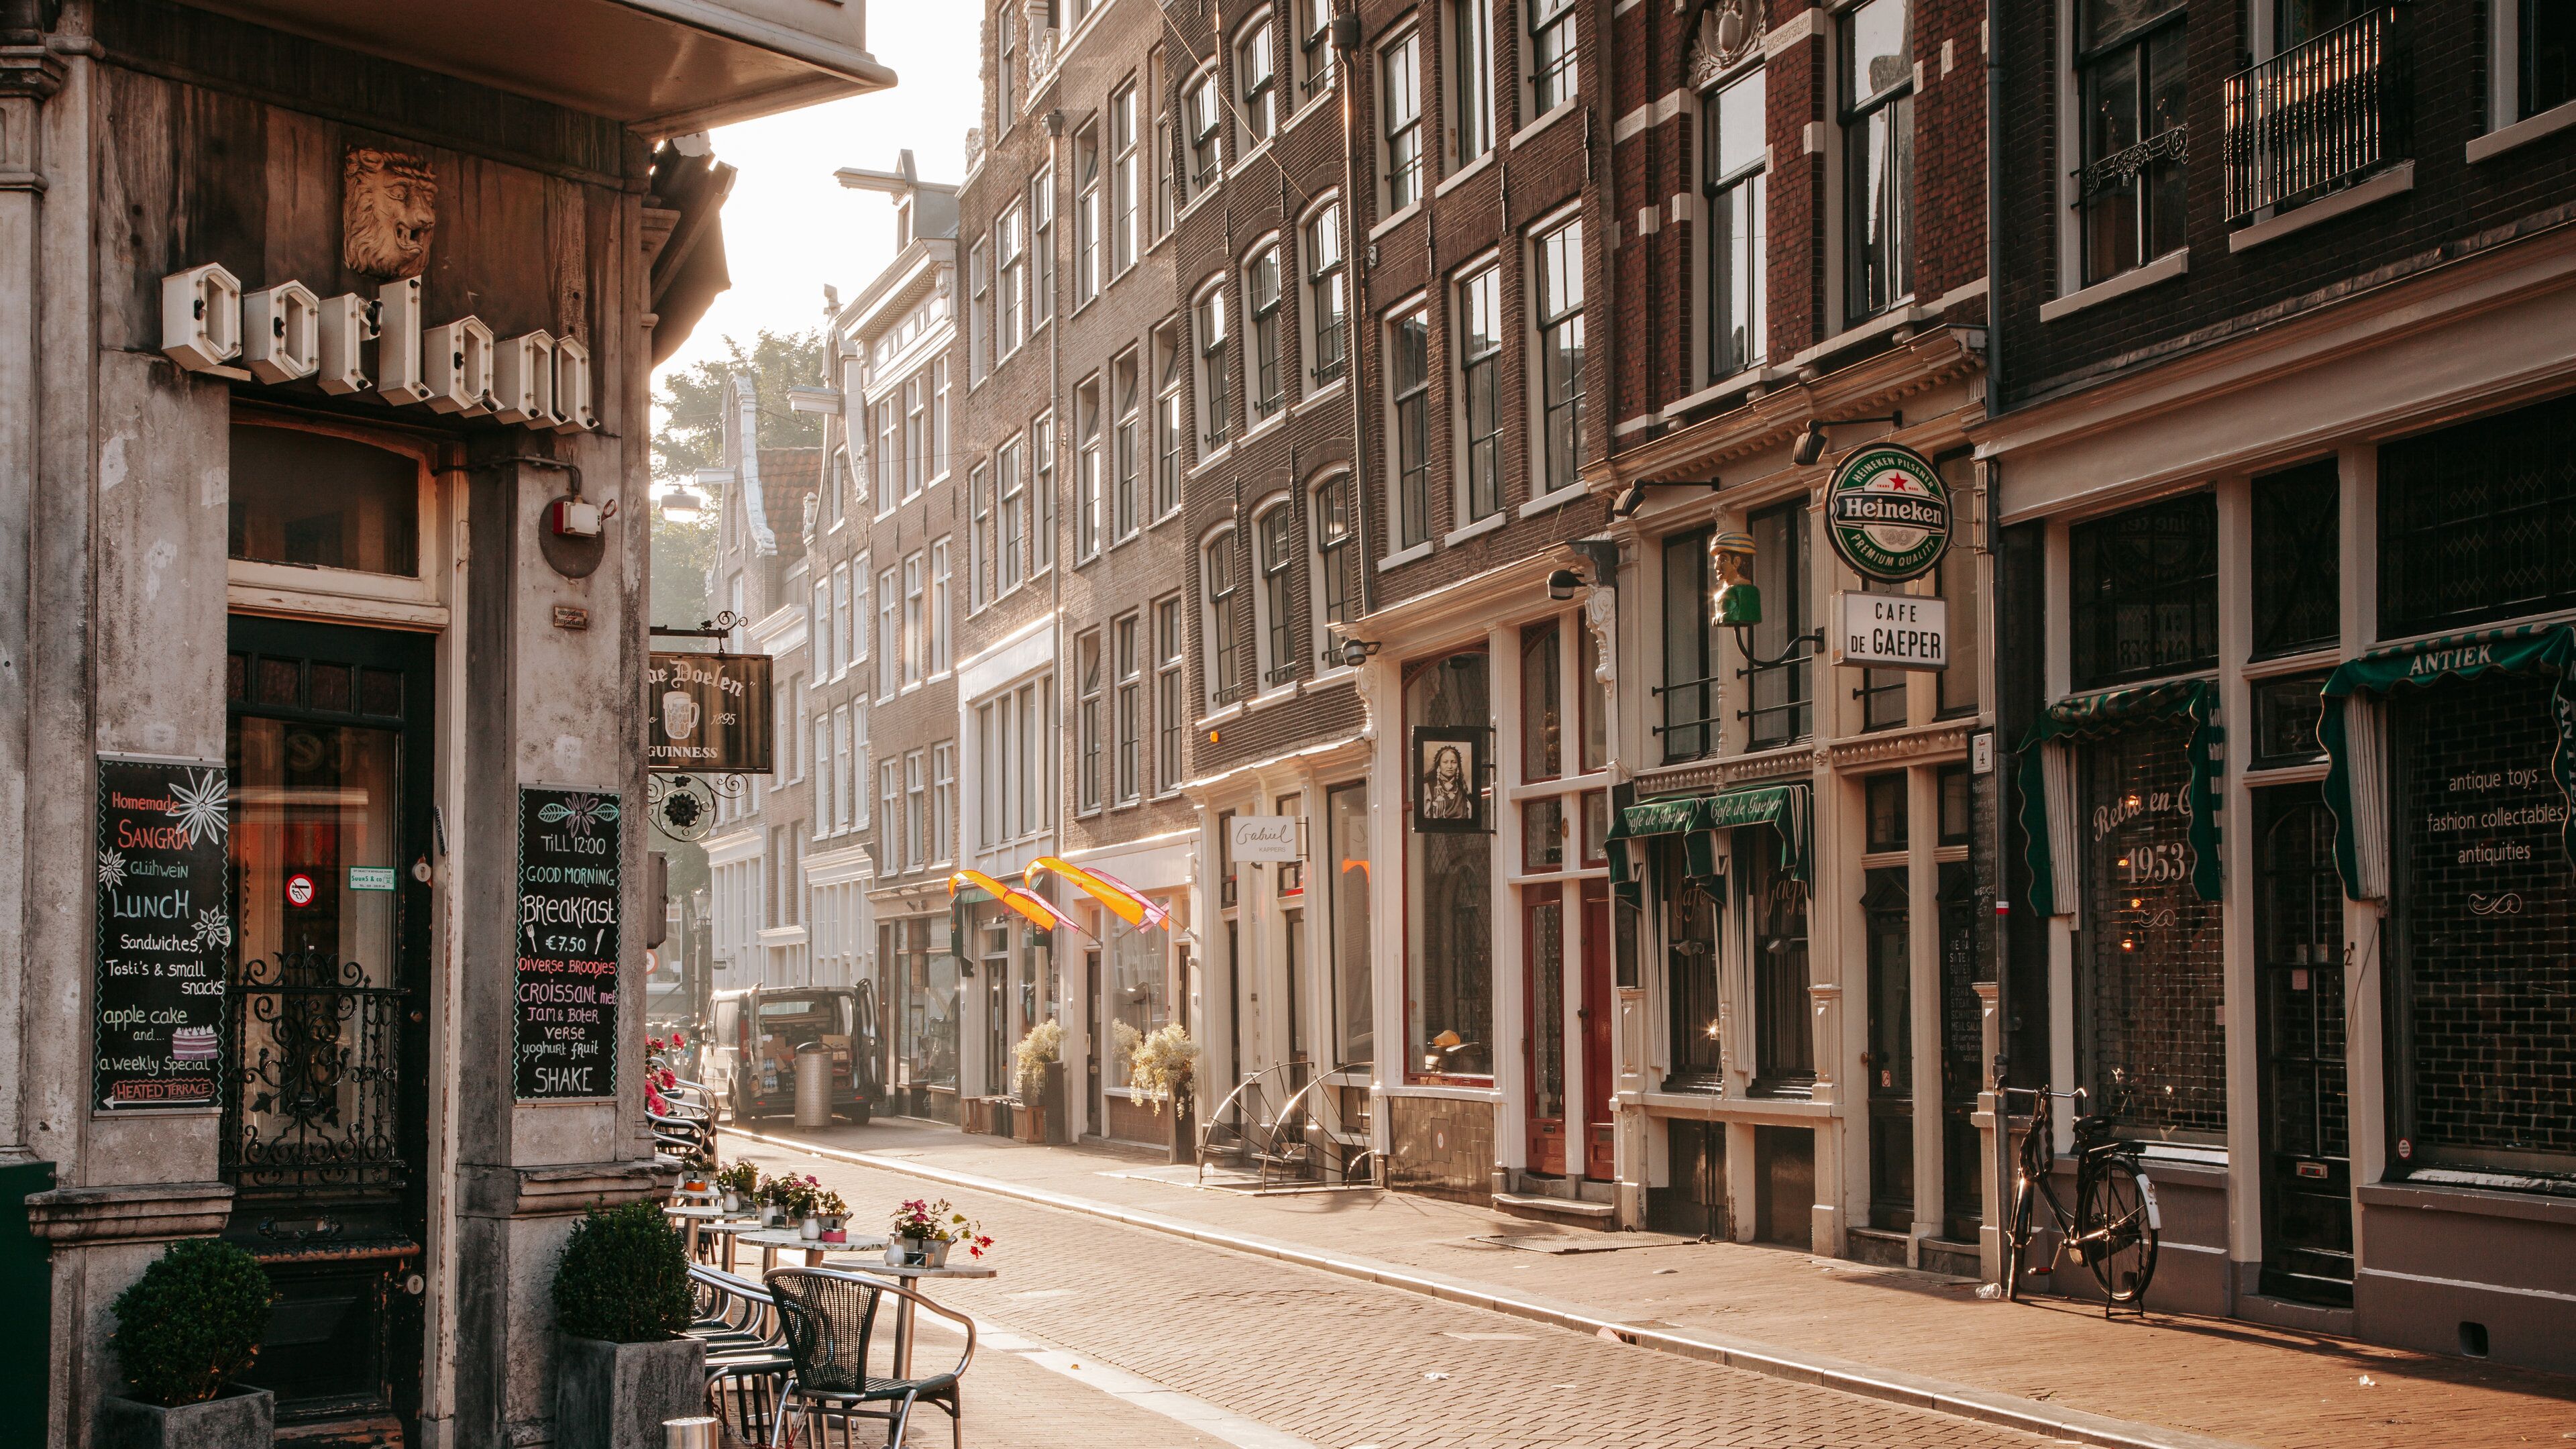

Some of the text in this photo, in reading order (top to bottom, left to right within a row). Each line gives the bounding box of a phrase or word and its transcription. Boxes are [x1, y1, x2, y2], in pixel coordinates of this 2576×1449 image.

[1852, 458, 1934, 488] HEINEKEN PILSENER
[1845, 498, 1942, 525] Heineken
[1850, 533, 1894, 568] PREMIUM
[1898, 539, 1935, 568] QUALITY
[1875, 602, 1917, 623] CAFE
[1851, 628, 1941, 659] DE GAEPER
[2408, 644, 2492, 676] ANTIEK
[710, 712, 737, 726] 1895
[648, 746, 718, 759] GUINNESS
[1979, 751, 1986, 764] 4
[2449, 768, 2538, 793] antique toys
[112, 792, 181, 813] Homemade
[1711, 799, 1733, 825] Café
[1733, 802, 1745, 816] de
[1645, 812, 1656, 826] de
[2093, 794, 2145, 843] Retro
[2149, 792, 2171, 812] en
[2427, 803, 2565, 832] fashion collectables
[574, 837, 606, 855] 12:00
[2458, 841, 2532, 866] antiquities
[526, 865, 561, 883] GOOD
[2125, 843, 2186, 884] 1953
[112, 889, 190, 919] LUNCH
[120, 933, 203, 955] Sandwiches,
[1142, 954, 1159, 971] DIJK
[2344, 948, 2353, 966] 2
[106, 959, 206, 977] Tosti's & small
[181, 979, 225, 996] snacks
[600, 989, 616, 1005] met
[103, 1004, 188, 1031] apple cake
[557, 1011, 564, 1021] &
[100, 1058, 111, 1071] a
[163, 1055, 211, 1076] Special
[533, 1067, 593, 1093] SHAKE
[116, 1083, 209, 1099] HEATED TERRACE
